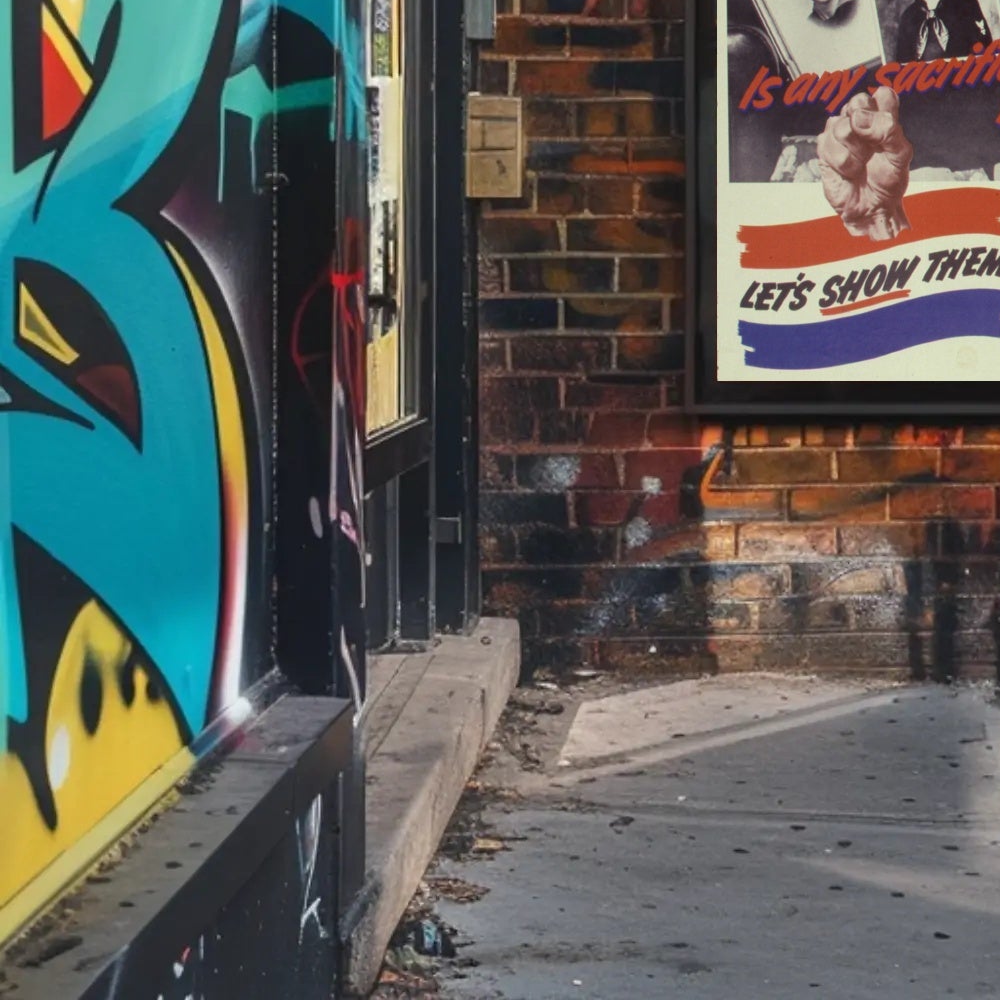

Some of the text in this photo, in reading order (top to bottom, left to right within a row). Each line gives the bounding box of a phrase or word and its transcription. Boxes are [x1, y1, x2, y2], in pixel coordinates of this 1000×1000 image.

[738, 65, 783, 112] Is
[783, 65, 867, 116] any
[739, 272, 816, 312] LET'S
[818, 256, 921, 308] SHOW
